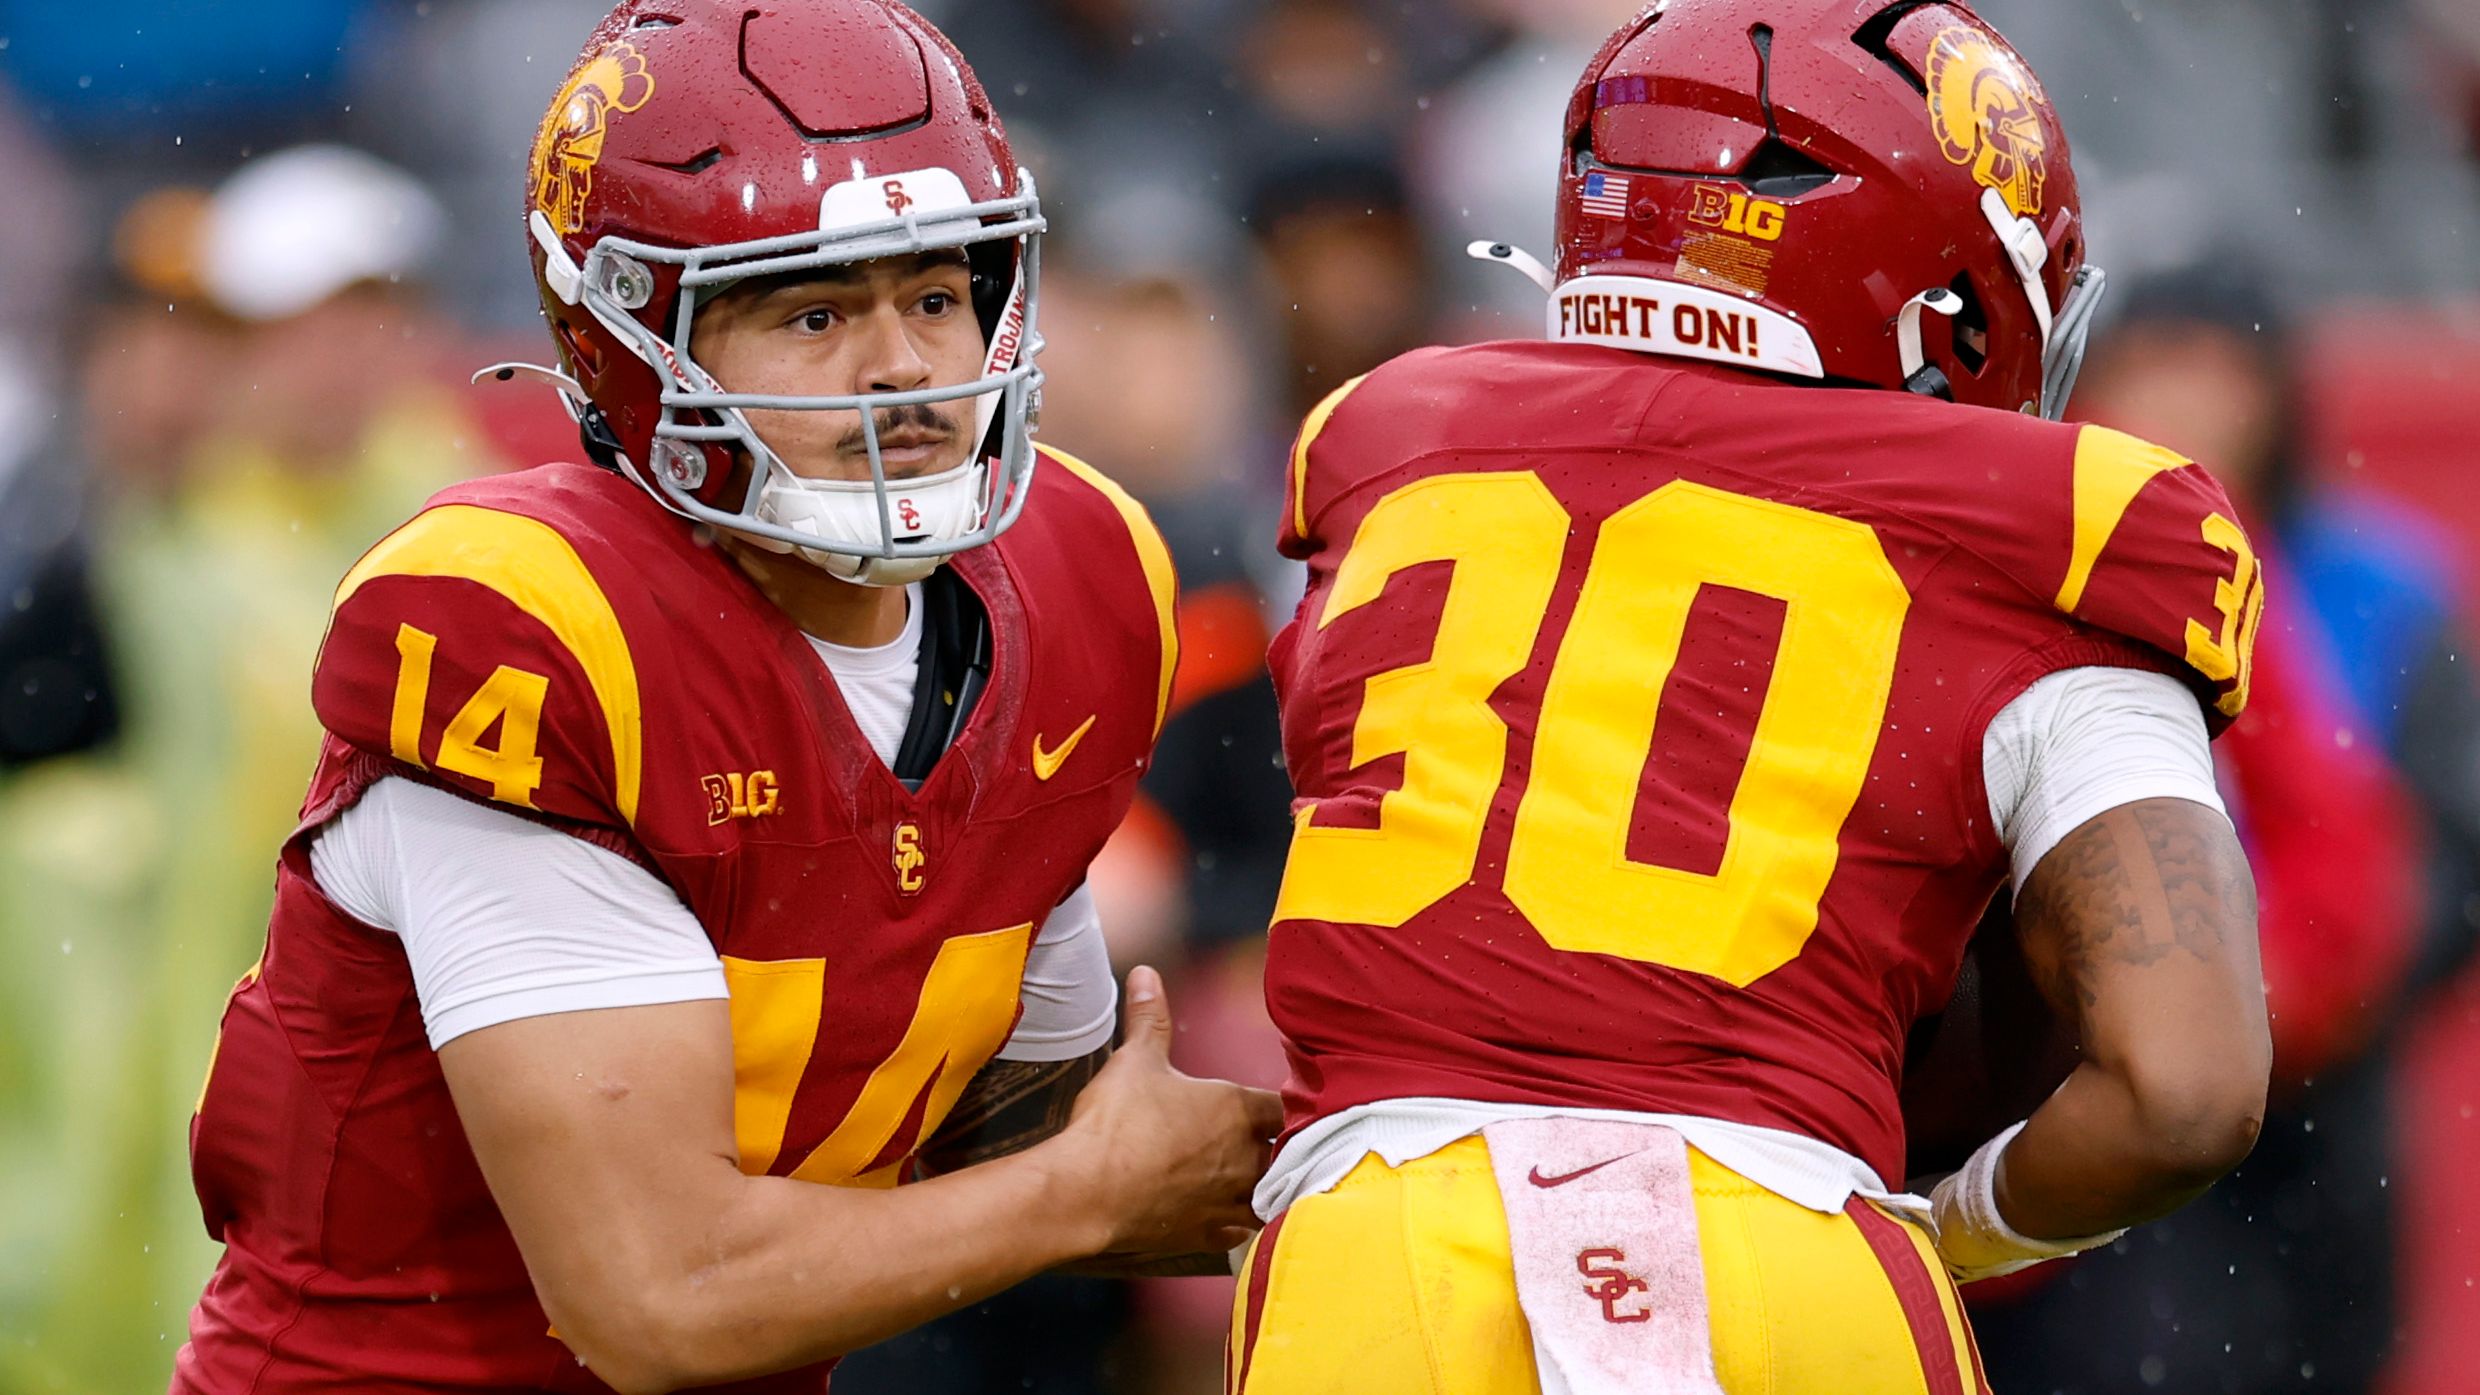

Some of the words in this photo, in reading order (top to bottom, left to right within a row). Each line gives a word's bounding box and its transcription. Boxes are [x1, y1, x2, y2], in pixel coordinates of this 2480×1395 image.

[1560, 294, 1659, 338] FIGHT
[1673, 303, 1759, 358] ON!
[390, 622, 549, 812] 14
[1268, 470, 1912, 988] 30
[895, 825, 925, 891] SC
[1577, 1248, 1651, 1324] SC
